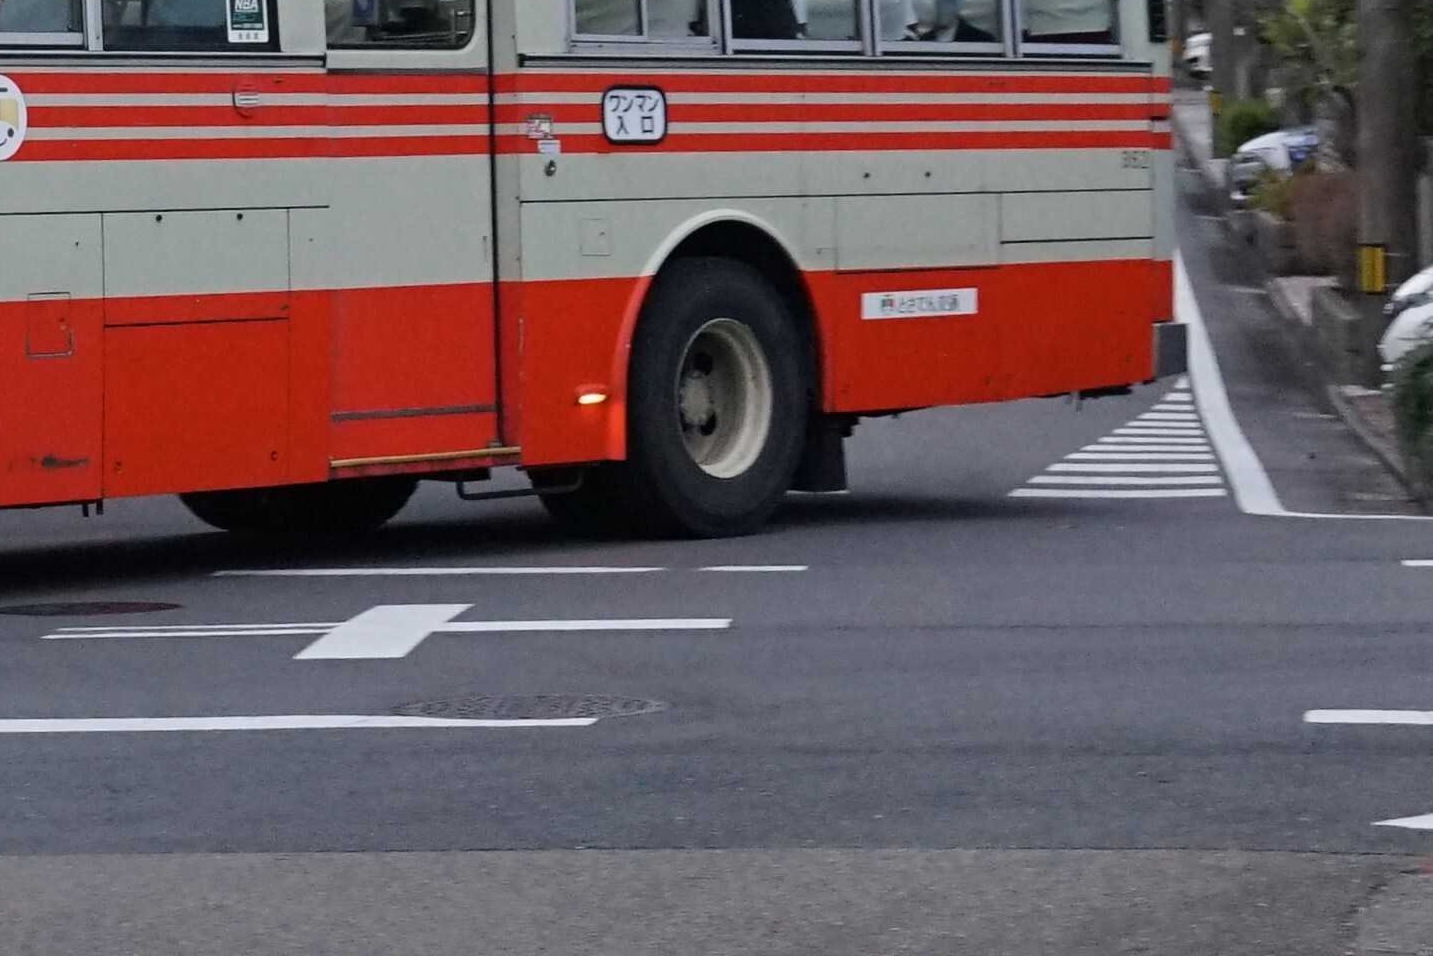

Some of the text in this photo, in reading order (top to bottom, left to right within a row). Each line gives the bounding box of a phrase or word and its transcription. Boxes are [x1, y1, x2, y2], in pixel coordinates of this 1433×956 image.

[609, 95, 660, 112] ワンマン
[616, 116, 655, 135] 入口
